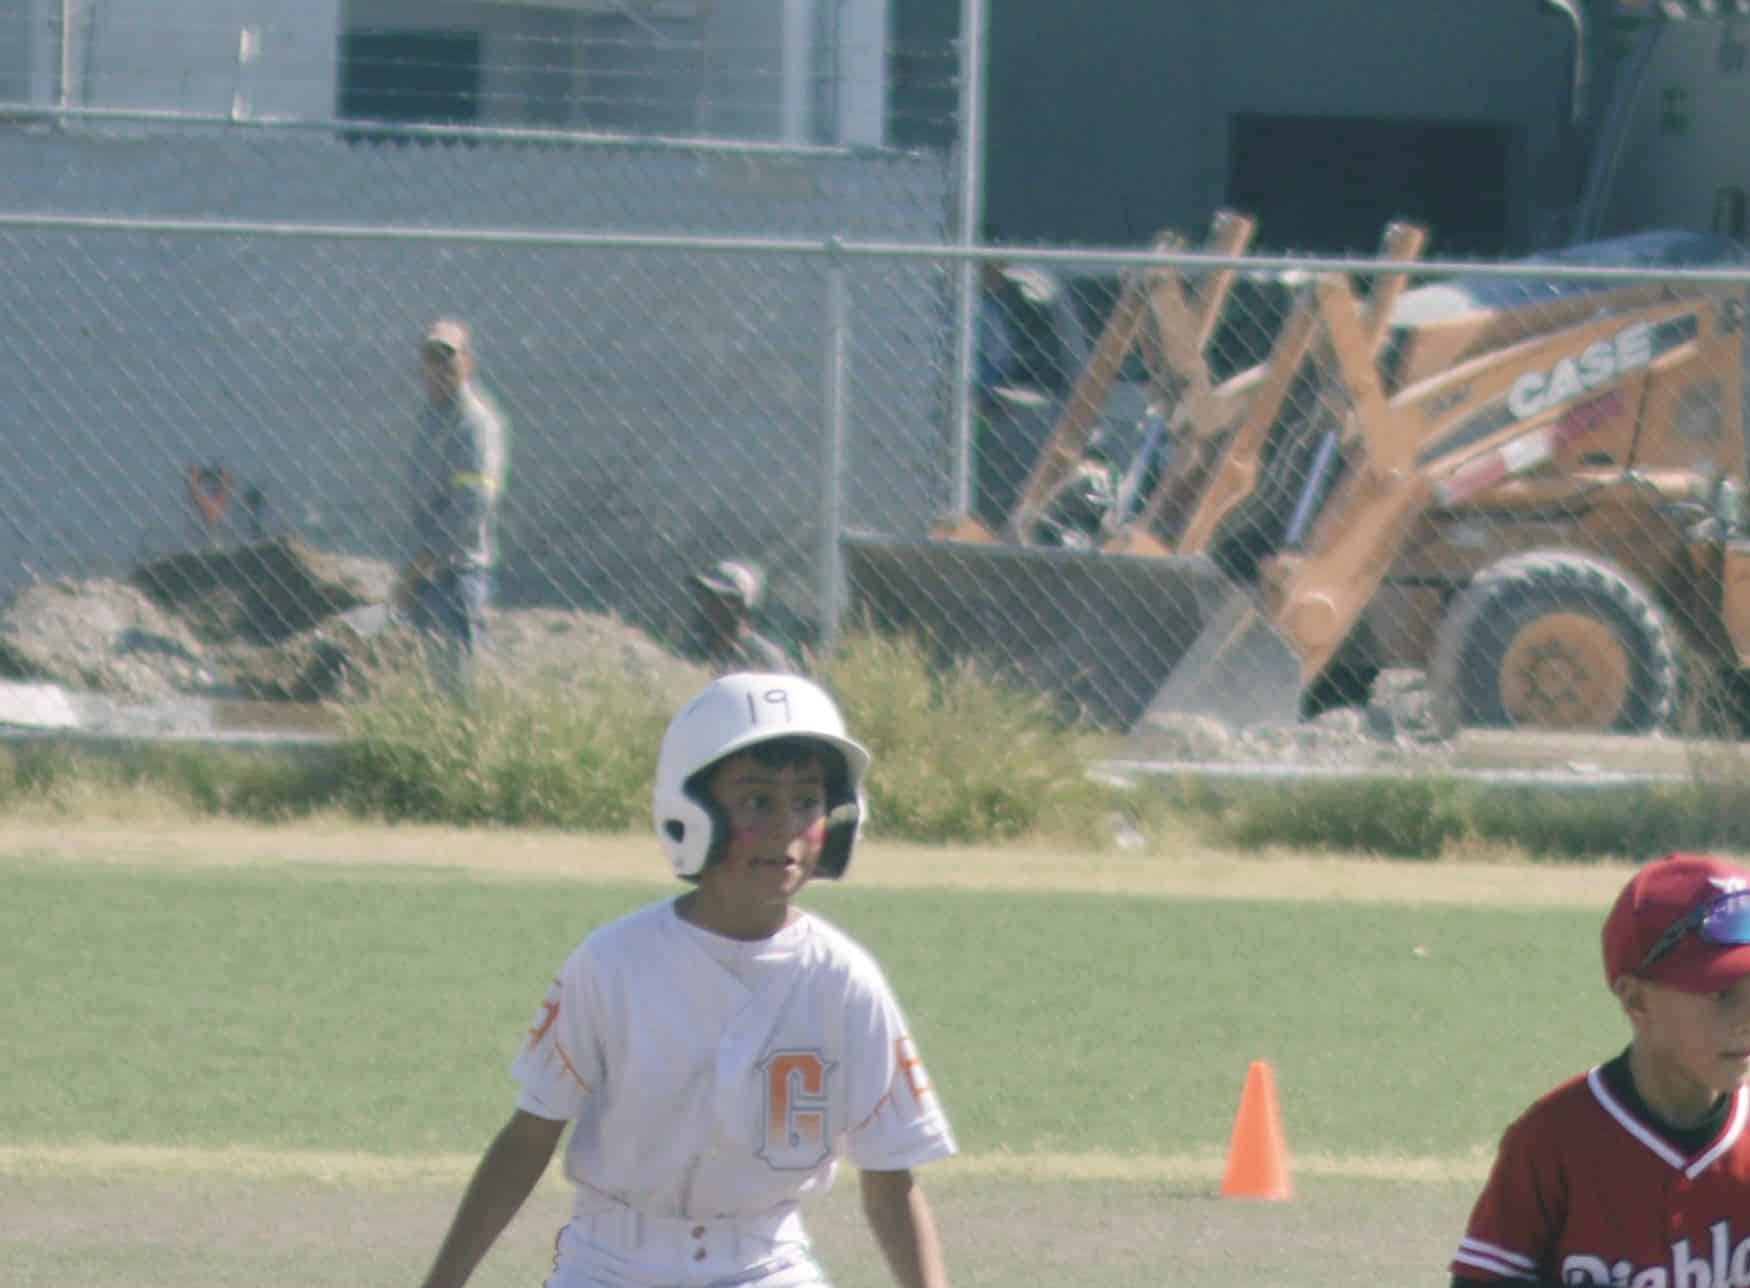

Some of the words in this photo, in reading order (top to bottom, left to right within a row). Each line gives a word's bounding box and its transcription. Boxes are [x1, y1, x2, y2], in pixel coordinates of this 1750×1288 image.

[1508, 321, 1652, 420] CASE
[746, 688, 792, 725] 19
[752, 1047, 840, 1170] G
